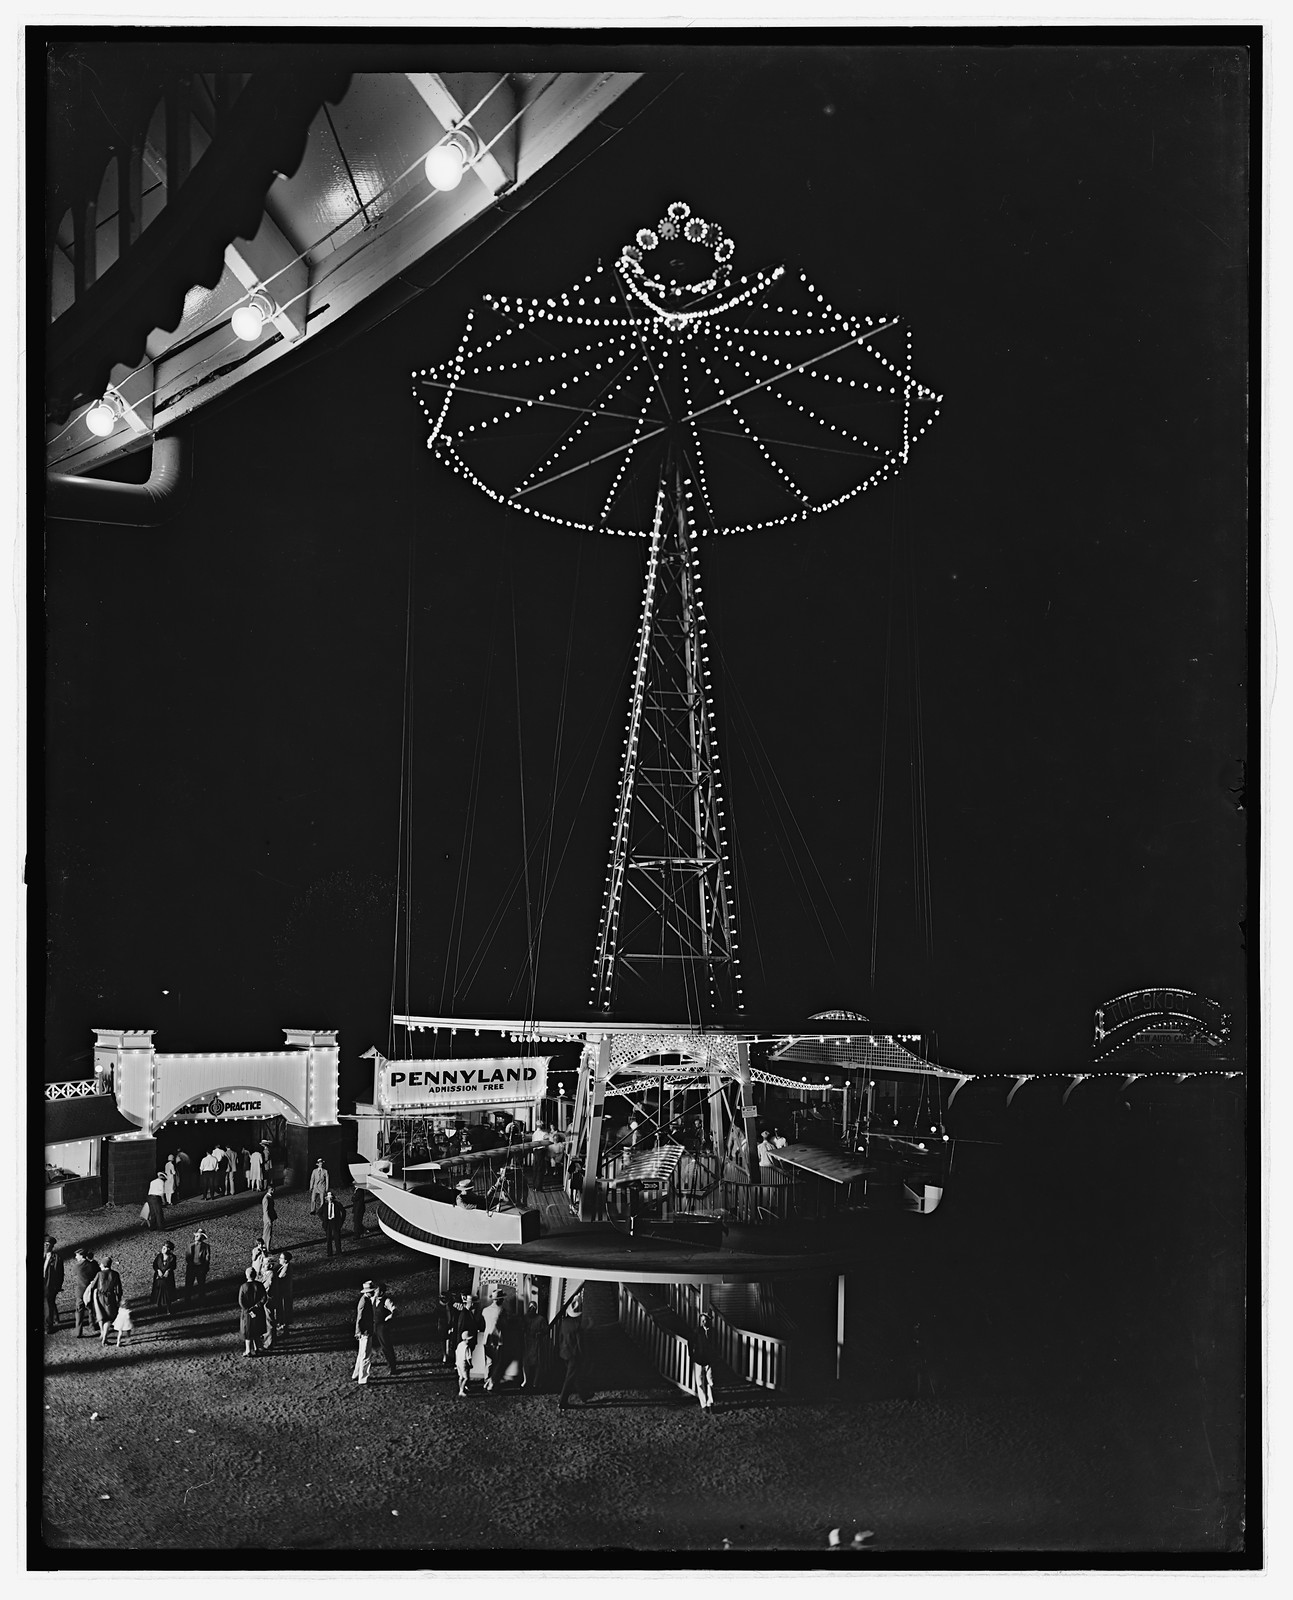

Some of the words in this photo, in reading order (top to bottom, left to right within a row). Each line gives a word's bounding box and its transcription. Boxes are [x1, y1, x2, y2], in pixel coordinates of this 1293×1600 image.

[1107, 995, 1142, 1022] THE
[1152, 1034, 1171, 1043] AUTO
[1174, 1034, 1192, 1043] CARS
[391, 1068, 538, 1087] PENNYLAND
[428, 1085, 478, 1094] ADMISSION
[483, 1083, 505, 1091] FREE
[174, 1104, 209, 1115] ARGET
[224, 1101, 262, 1111] PRACTICE
